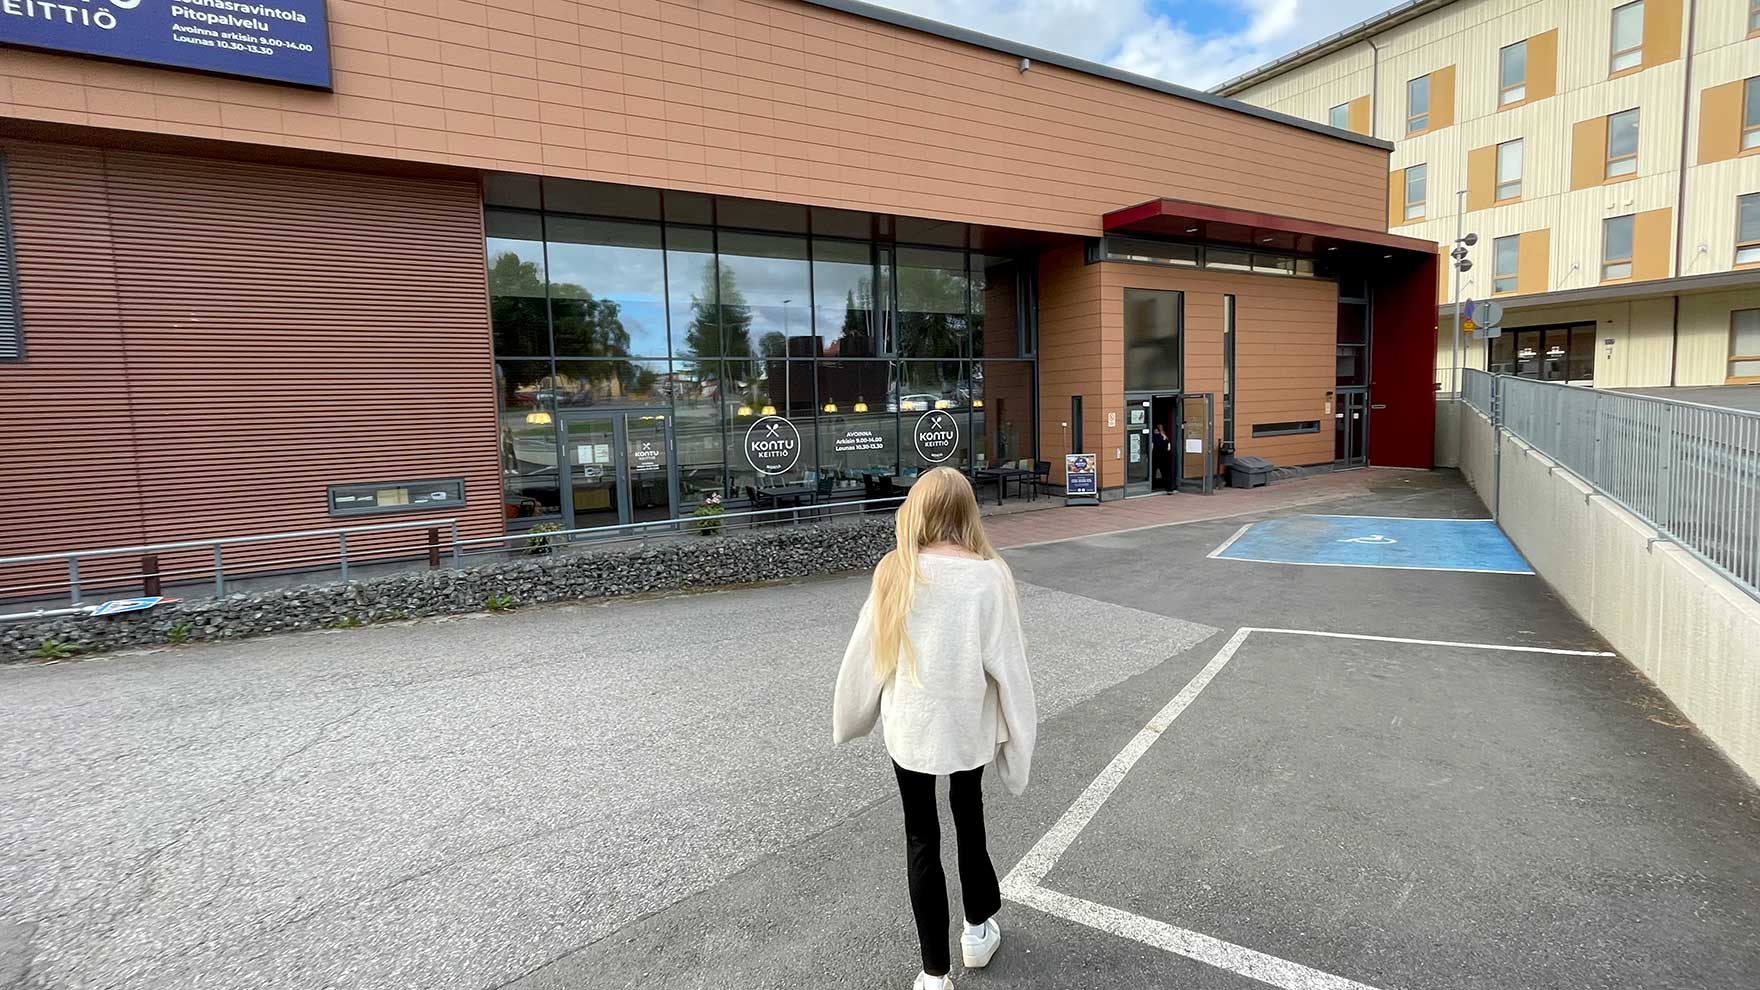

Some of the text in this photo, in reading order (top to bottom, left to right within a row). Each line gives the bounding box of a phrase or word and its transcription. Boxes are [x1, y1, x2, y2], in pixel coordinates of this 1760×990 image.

[3, 0, 117, 29] EITTIÖ
[171, 5, 269, 31] Pitopalvelu
[173, 0, 307, 23] unasravintola
[172, 23, 313, 52] Avoinna arkisin 9.00-14.00
[173, 33, 274, 55] Lounas 10.30-13.30
[751, 439, 794, 451] KONTU
[920, 431, 954, 441] KONTU
[758, 450, 789, 458] KEITTIÖ
